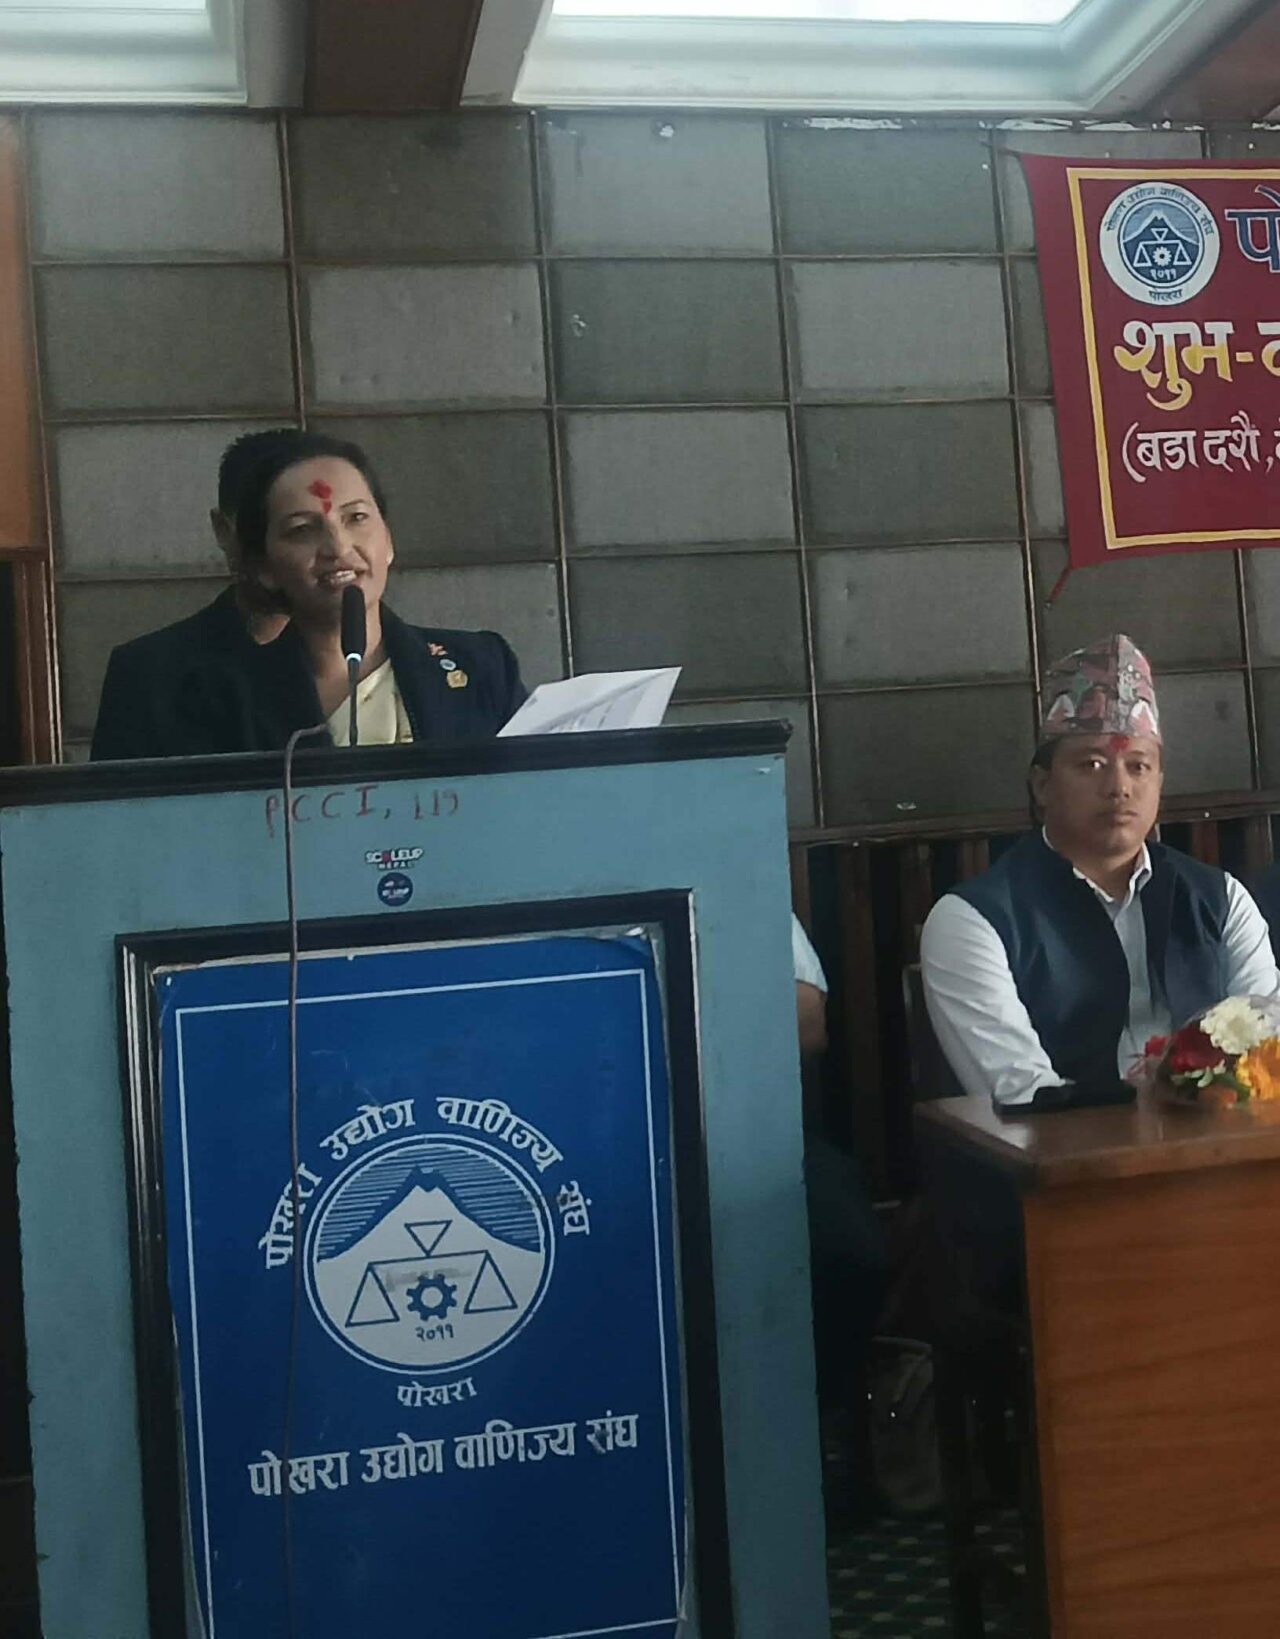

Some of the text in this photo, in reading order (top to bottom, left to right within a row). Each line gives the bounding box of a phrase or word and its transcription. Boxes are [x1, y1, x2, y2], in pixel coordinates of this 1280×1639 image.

[320, 1099, 416, 1160] उद्योग
[436, 1097, 564, 1173] वाणिज्य
[556, 1180, 592, 1236] संघ
[415, 1323, 454, 1342] २०११
[397, 1377, 477, 1407] पोखरा
[248, 1410, 639, 1497] पोखरा उद्योग वाणिज्य संघ
